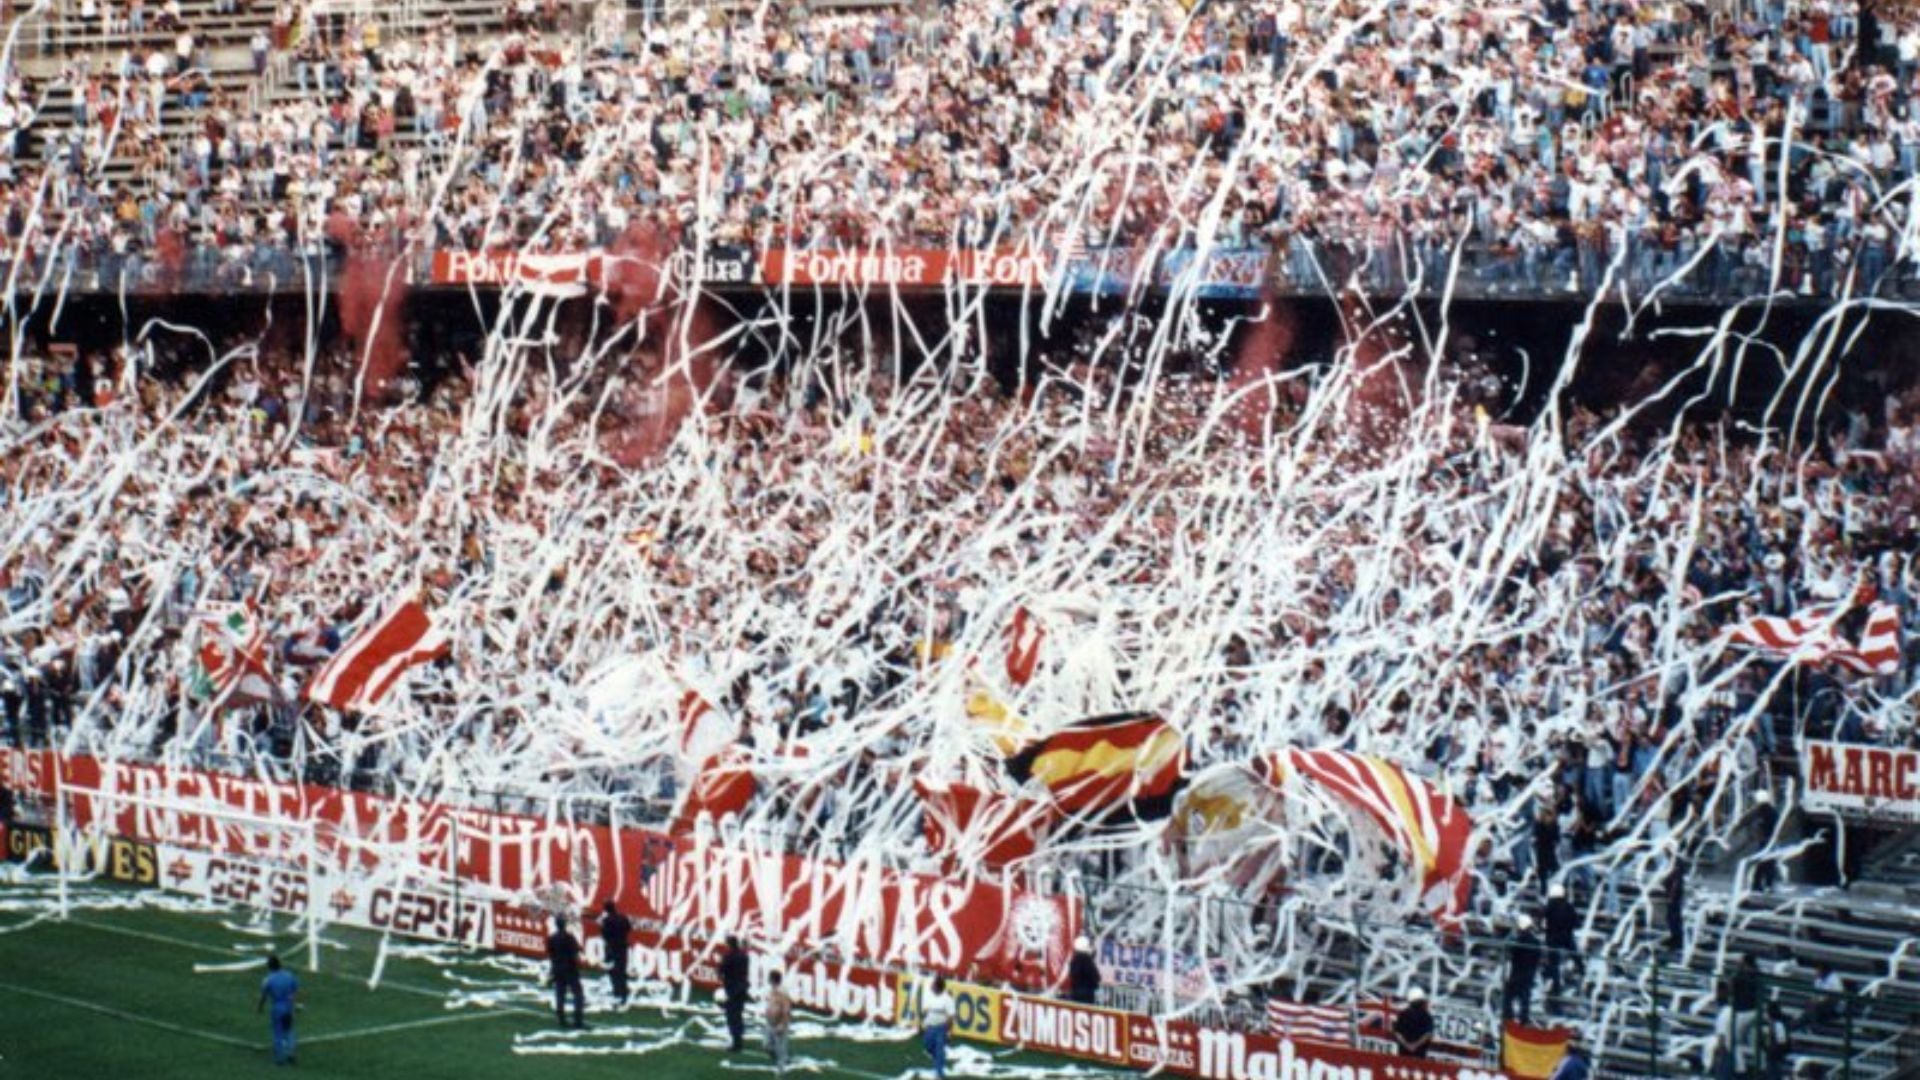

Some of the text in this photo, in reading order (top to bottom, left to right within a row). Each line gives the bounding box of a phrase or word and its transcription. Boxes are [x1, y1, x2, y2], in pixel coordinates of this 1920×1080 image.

[783, 250, 927, 284] Fortuna
[968, 250, 1047, 284] Fort
[1808, 744, 1920, 800] MARC
[100, 763, 303, 860] FRENTE
[901, 979, 992, 1033] ZOS
[1003, 999, 1122, 1058] ZUMOSOL
